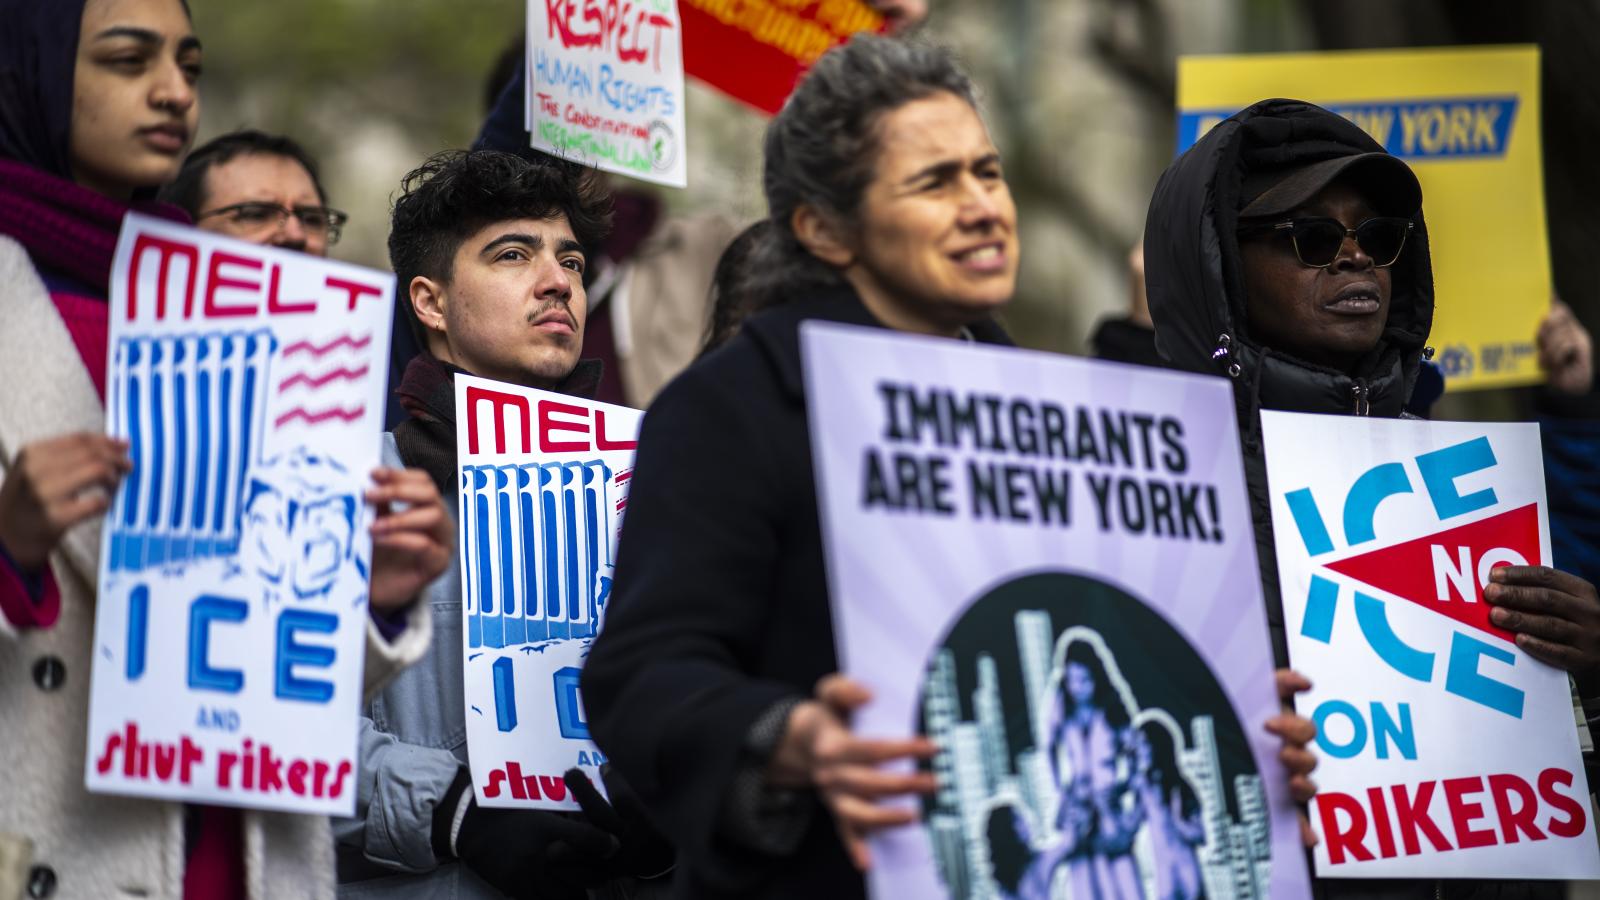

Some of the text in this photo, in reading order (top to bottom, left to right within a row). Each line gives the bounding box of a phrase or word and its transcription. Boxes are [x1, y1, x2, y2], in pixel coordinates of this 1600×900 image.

[544, 0, 673, 73] RESPECT
[535, 49, 676, 116] HUMAN RIGHTS
[1401, 103, 1500, 155] YORK
[126, 232, 383, 321] MELT
[467, 386, 637, 454] MEL
[877, 378, 1189, 475] IMMIGRANTS
[861, 446, 1224, 544] ARE NEW YORK!
[1284, 435, 1499, 557] ICE
[125, 583, 340, 704] ICE
[1300, 573, 1525, 720] ICE
[196, 706, 241, 733] AND
[1311, 699, 1417, 760] ON
[96, 721, 352, 798] shut rikers
[483, 761, 580, 802] shu
[577, 750, 608, 767] AN
[1316, 767, 1586, 865] RIKERS
